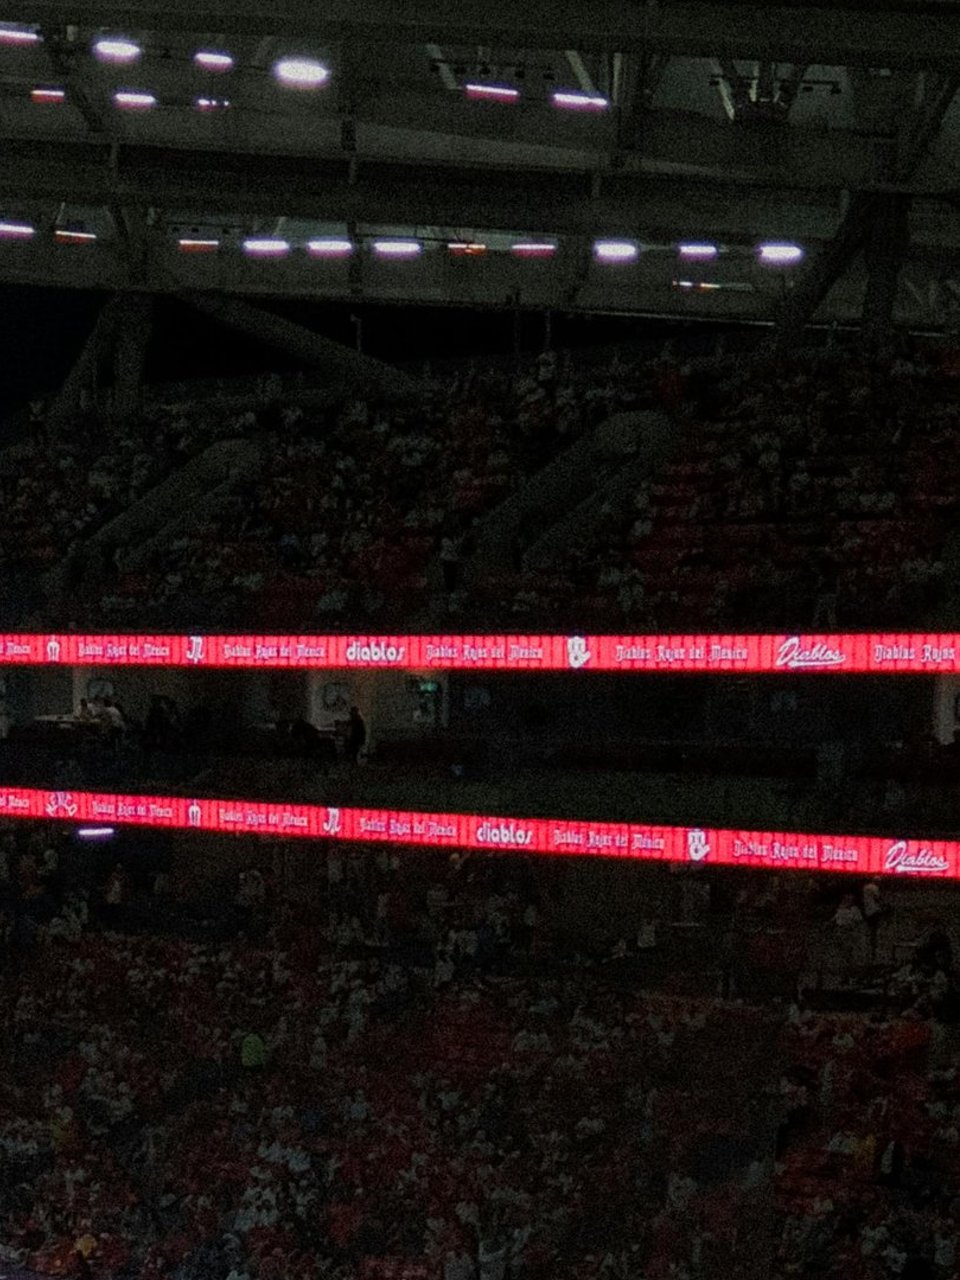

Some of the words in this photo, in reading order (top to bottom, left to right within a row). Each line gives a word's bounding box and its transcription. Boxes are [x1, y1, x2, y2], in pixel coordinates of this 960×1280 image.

[346, 641, 405, 660] diablos
[776, 637, 846, 667] Diablos
[477, 821, 533, 844] diablos
[885, 841, 950, 872] Diablos
